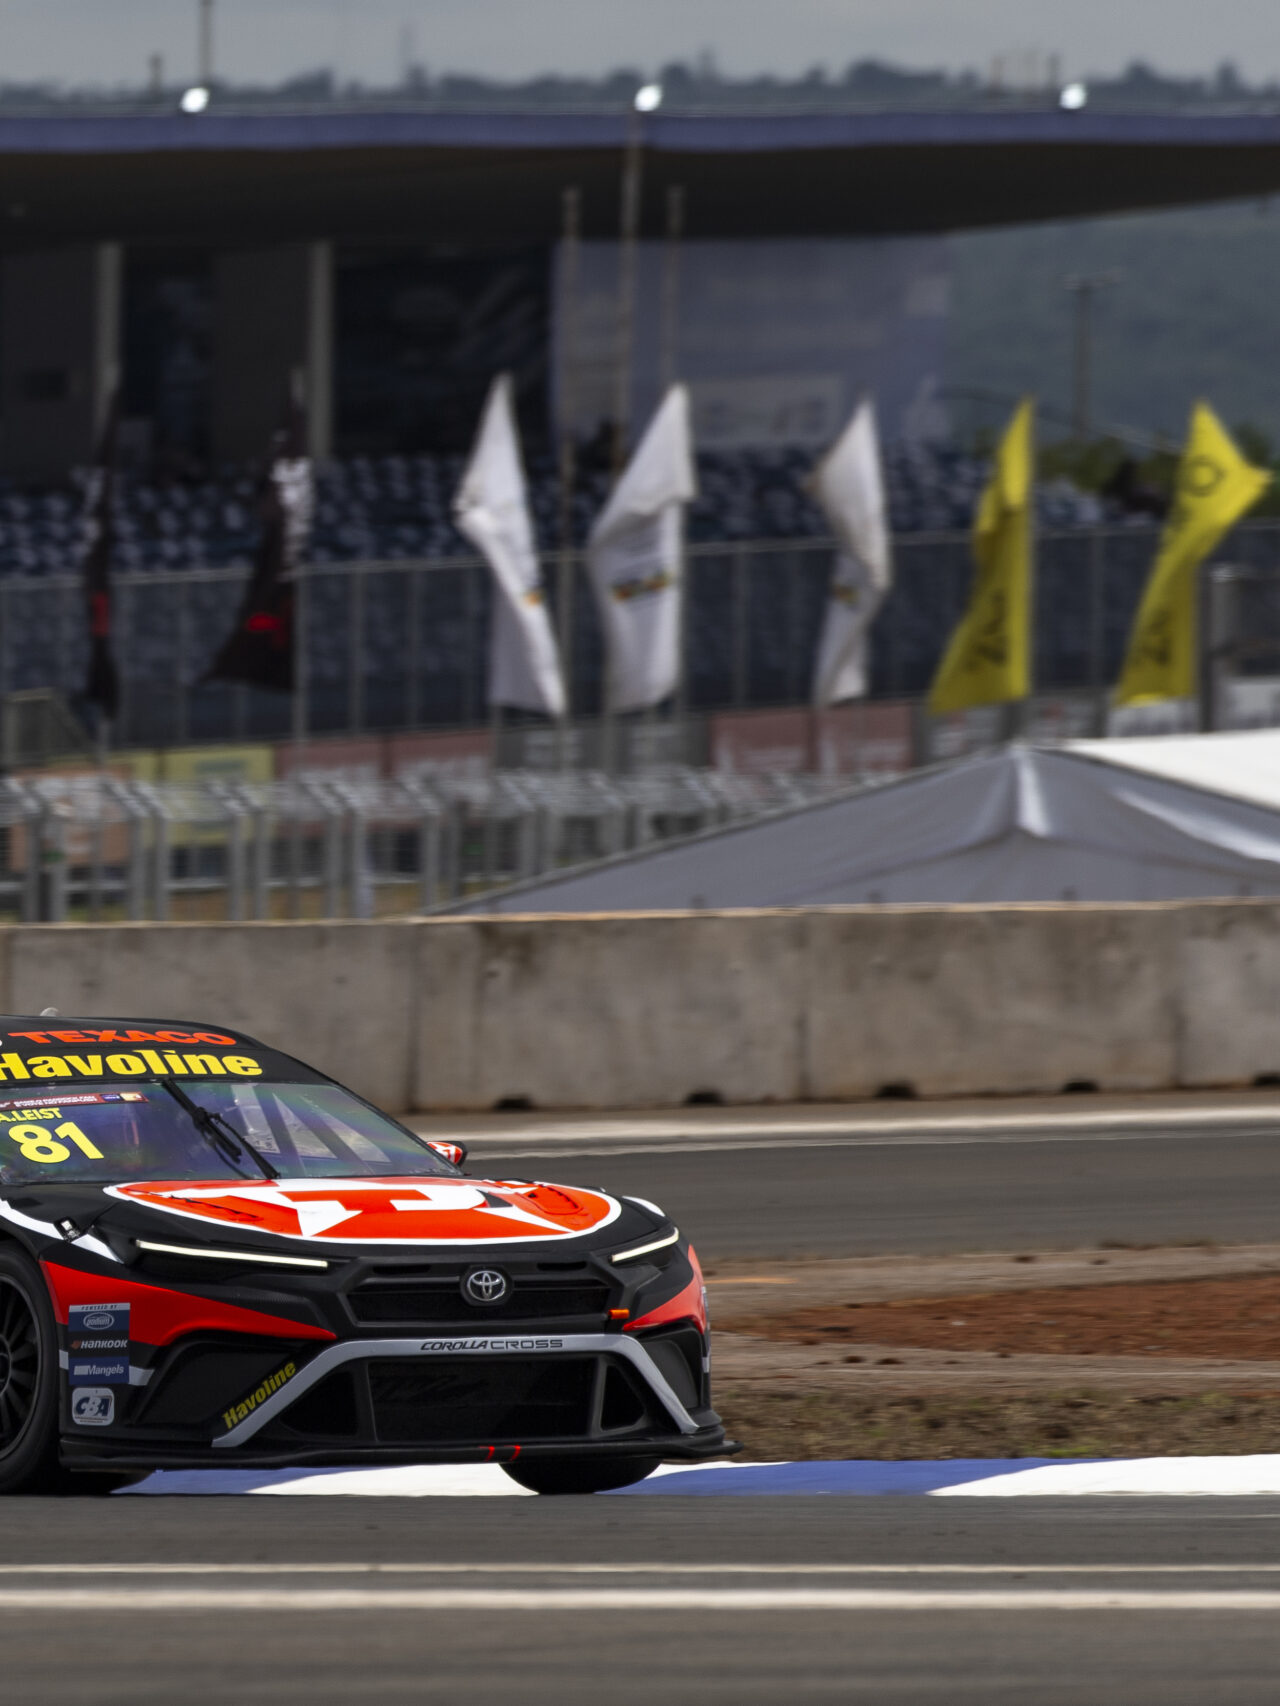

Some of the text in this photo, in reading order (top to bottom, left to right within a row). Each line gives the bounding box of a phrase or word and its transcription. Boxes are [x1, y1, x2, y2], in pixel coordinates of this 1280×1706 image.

[8, 1030, 237, 1045] TEXACO
[8, 1121, 105, 1164] 81
[420, 1339, 564, 1352] COROLLA CROSS
[87, 1364, 124, 1377] Mangels
[223, 1361, 297, 1430] Havoline
[75, 1396, 110, 1417] CBA
